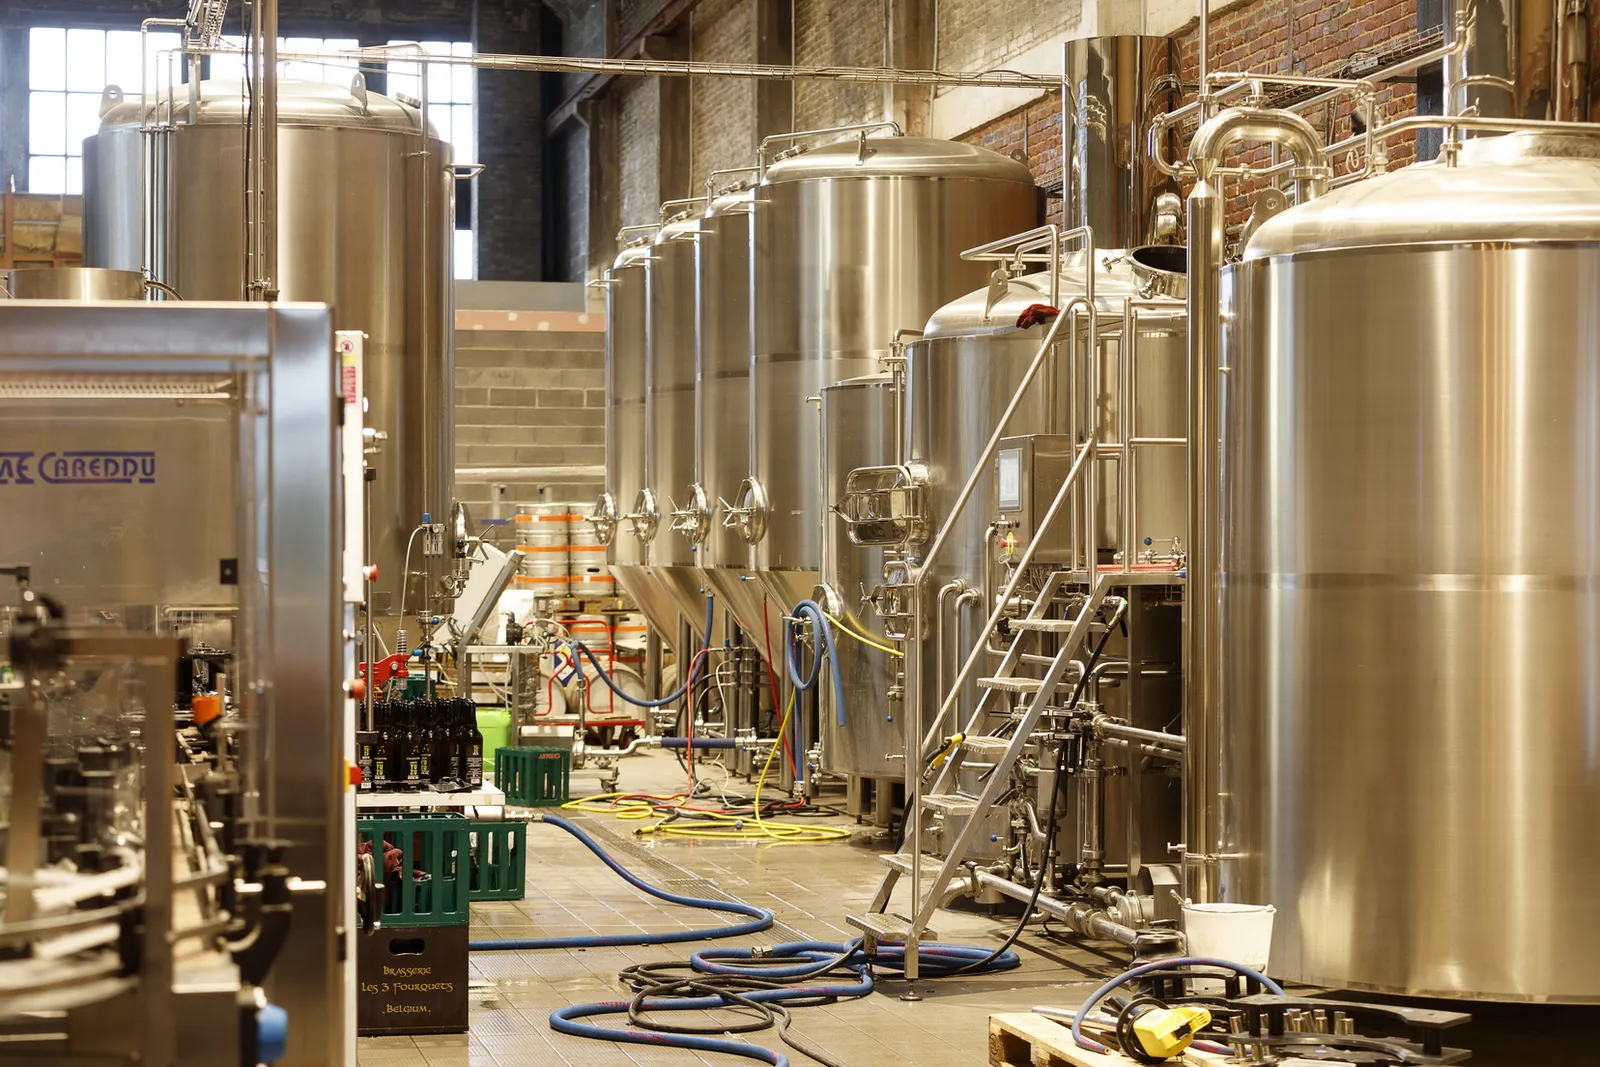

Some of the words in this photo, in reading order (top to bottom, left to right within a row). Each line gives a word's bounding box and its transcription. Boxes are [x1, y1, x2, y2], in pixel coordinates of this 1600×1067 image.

[38, 451, 155, 484] CAREDDU
[383, 965, 432, 978] BRASSERIE
[381, 983, 389, 992] 3
[393, 982, 453, 995] FOURQUETS
[386, 1003, 428, 1014] BELGIUM
